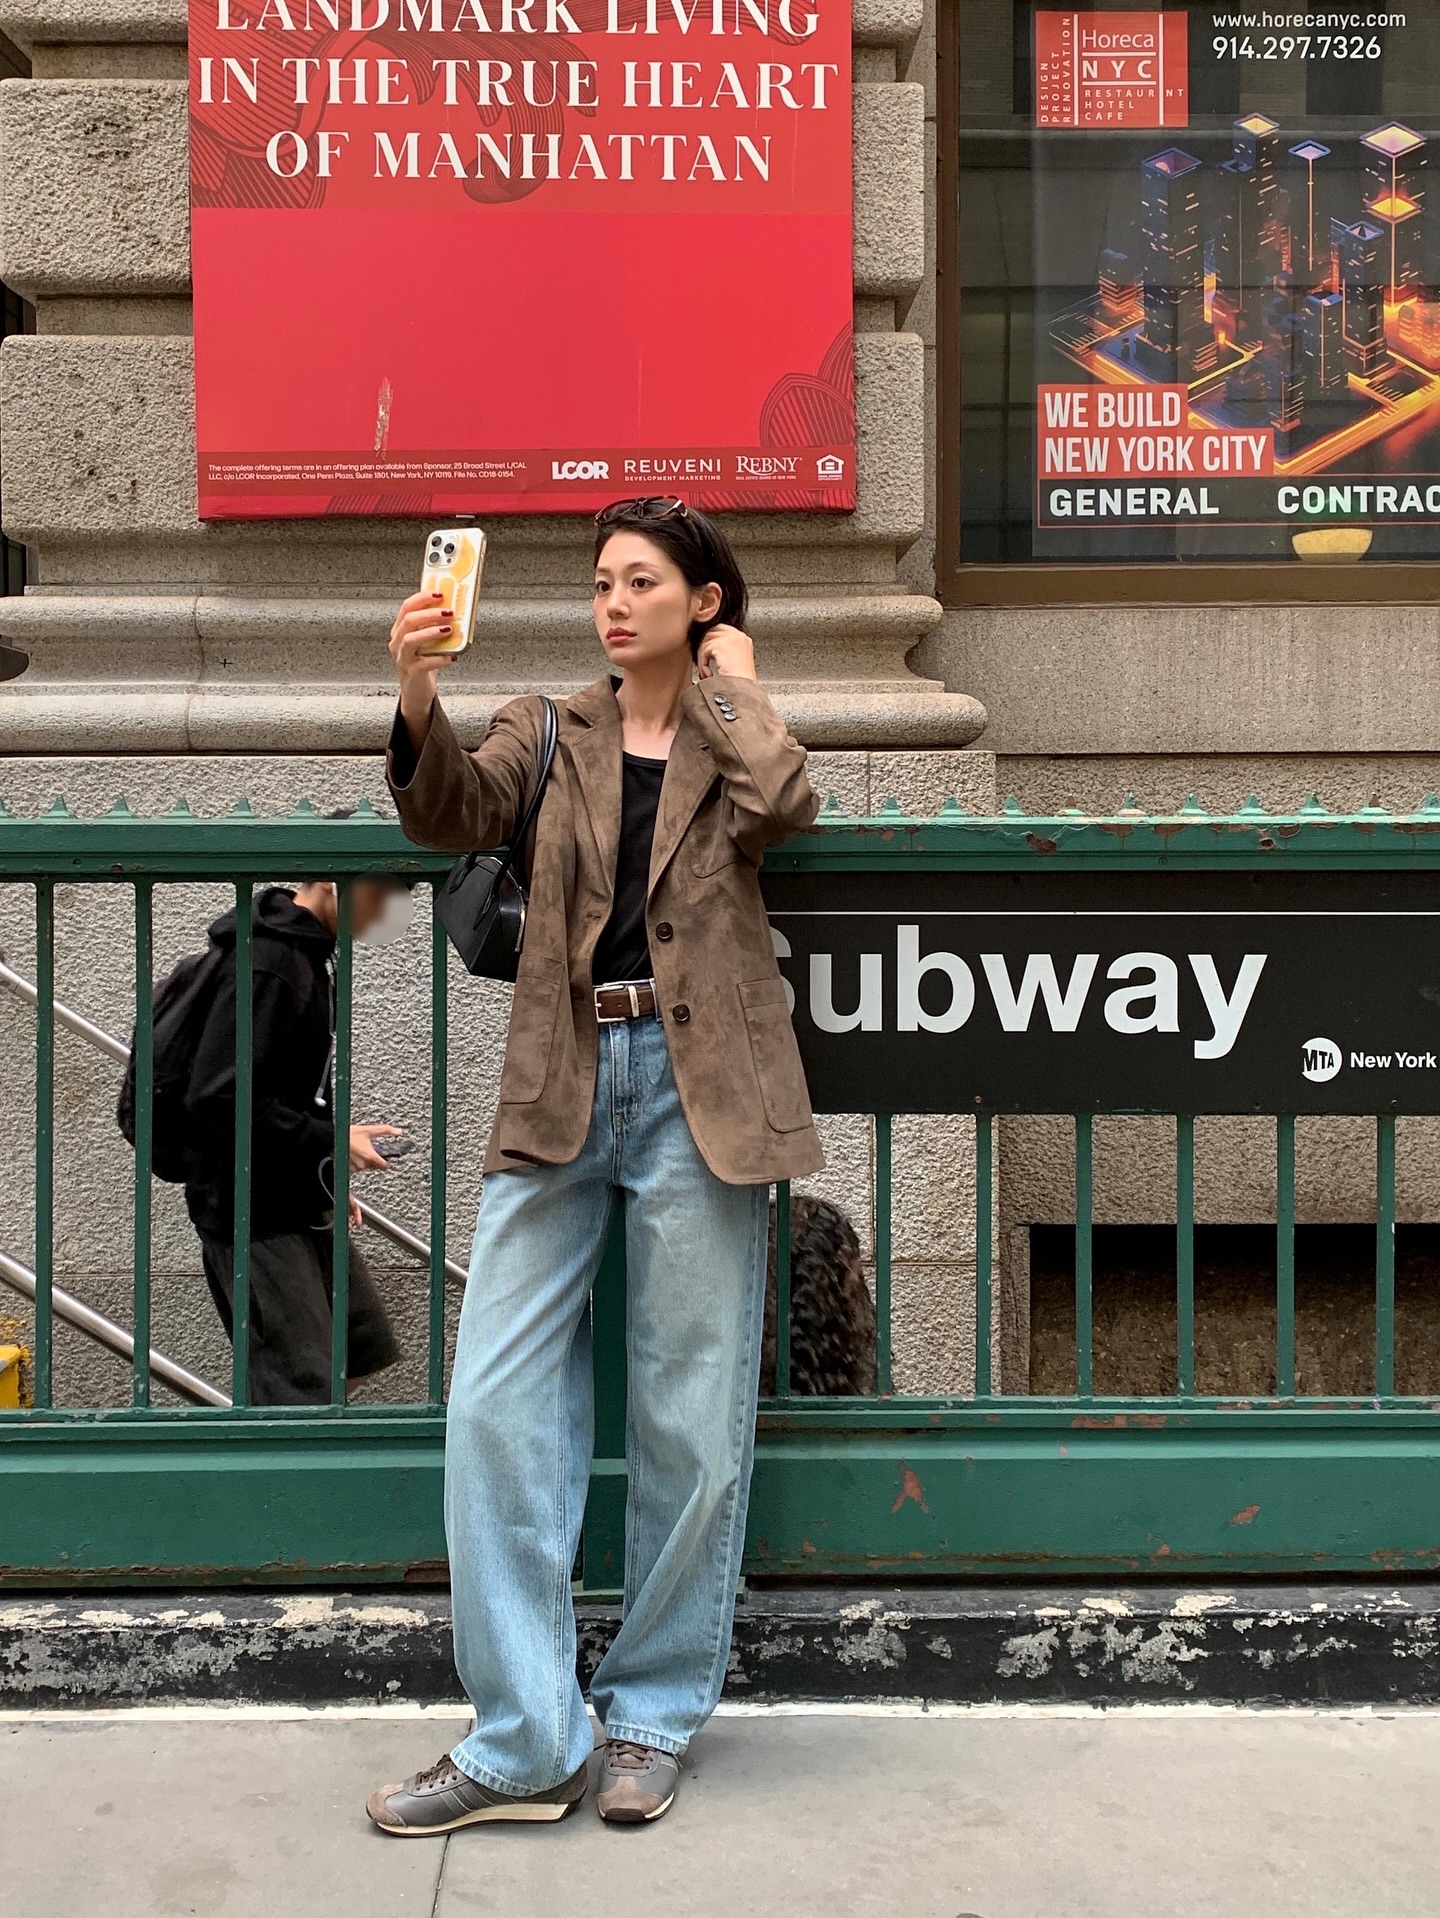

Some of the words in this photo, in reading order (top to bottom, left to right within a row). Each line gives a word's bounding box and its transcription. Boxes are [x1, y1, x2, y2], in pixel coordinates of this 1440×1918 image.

[213, 0, 582, 35] LANDMARK
[604, 0, 820, 38] LIVING
[1213, 11, 1406, 30] www.horecanyc.com
[1082, 29, 1154, 49] Horeca
[1212, 36, 1381, 60] 914.297.7326
[1062, 18, 1071, 122] RENOVATION
[1082, 60, 1152, 79] NYC
[198, 57, 259, 105] IN
[282, 58, 409, 106] THE
[433, 58, 599, 108] TRUE
[623, 61, 838, 110] HEART
[1041, 62, 1049, 122] DESIGN
[1052, 52, 1060, 122] PROJECT
[1085, 101, 1135, 109] HOTEL
[1085, 112, 1124, 120] CAFE
[265, 130, 350, 179] OF
[372, 131, 772, 182] MANHATTAN
[1044, 393, 1089, 429] WE
[1097, 391, 1181, 428] BUILD
[624, 458, 721, 473] REUVENI
[1045, 437, 1109, 473] NEW
[1118, 436, 1194, 472] YORK
[1202, 435, 1267, 471] CITY
[222, 464, 254, 472] complete
[254, 464, 282, 472] offering
[332, 463, 359, 471] offering
[360, 463, 374, 471] plan
[552, 461, 610, 480] LCOR
[1049, 487, 1219, 517] GENERAL
[1277, 485, 1440, 515] CONTRAC
[1350, 1052, 1391, 1068] New
[1394, 1052, 1437, 1068] York
